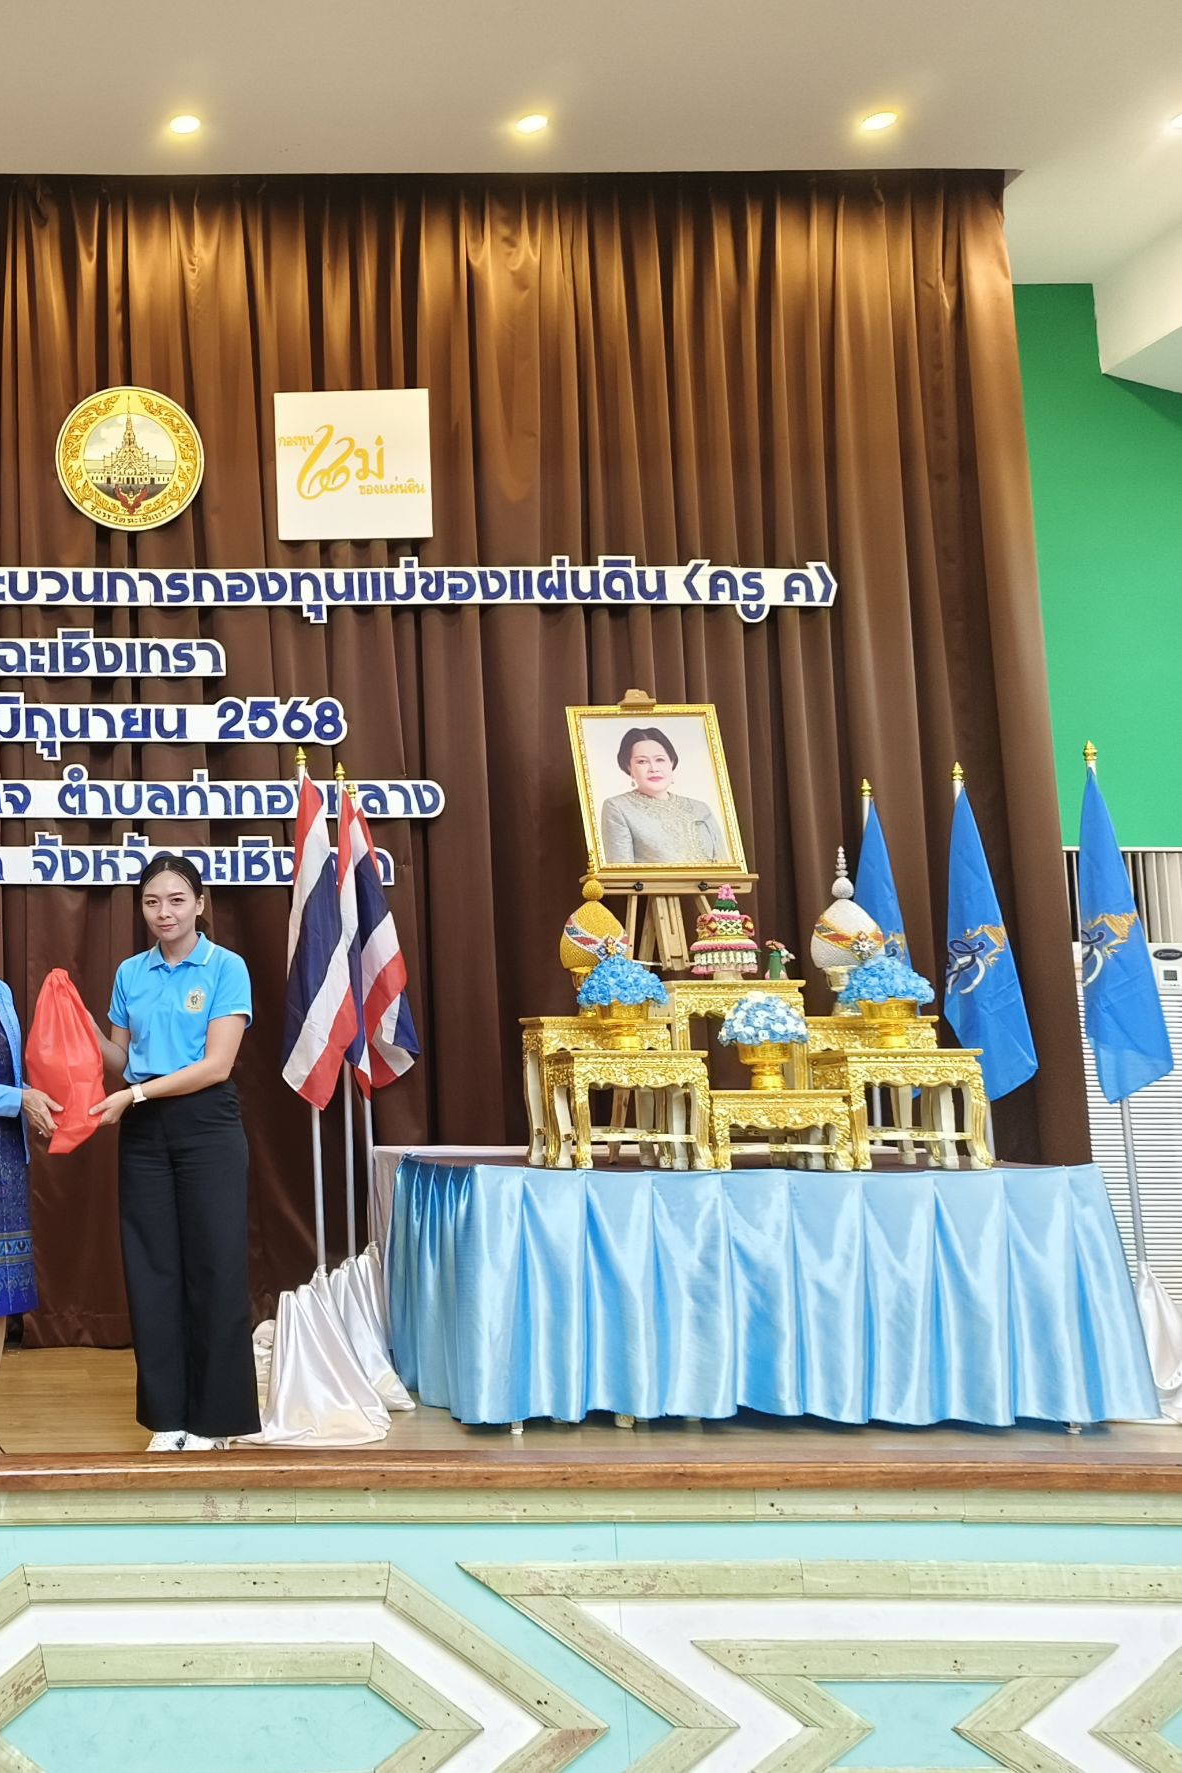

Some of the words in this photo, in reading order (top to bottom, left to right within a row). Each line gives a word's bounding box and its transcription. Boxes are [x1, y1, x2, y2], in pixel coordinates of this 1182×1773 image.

[217, 700, 345, 741] 2568
[58, 767, 440, 815] ตำบลท่าทอลาง
